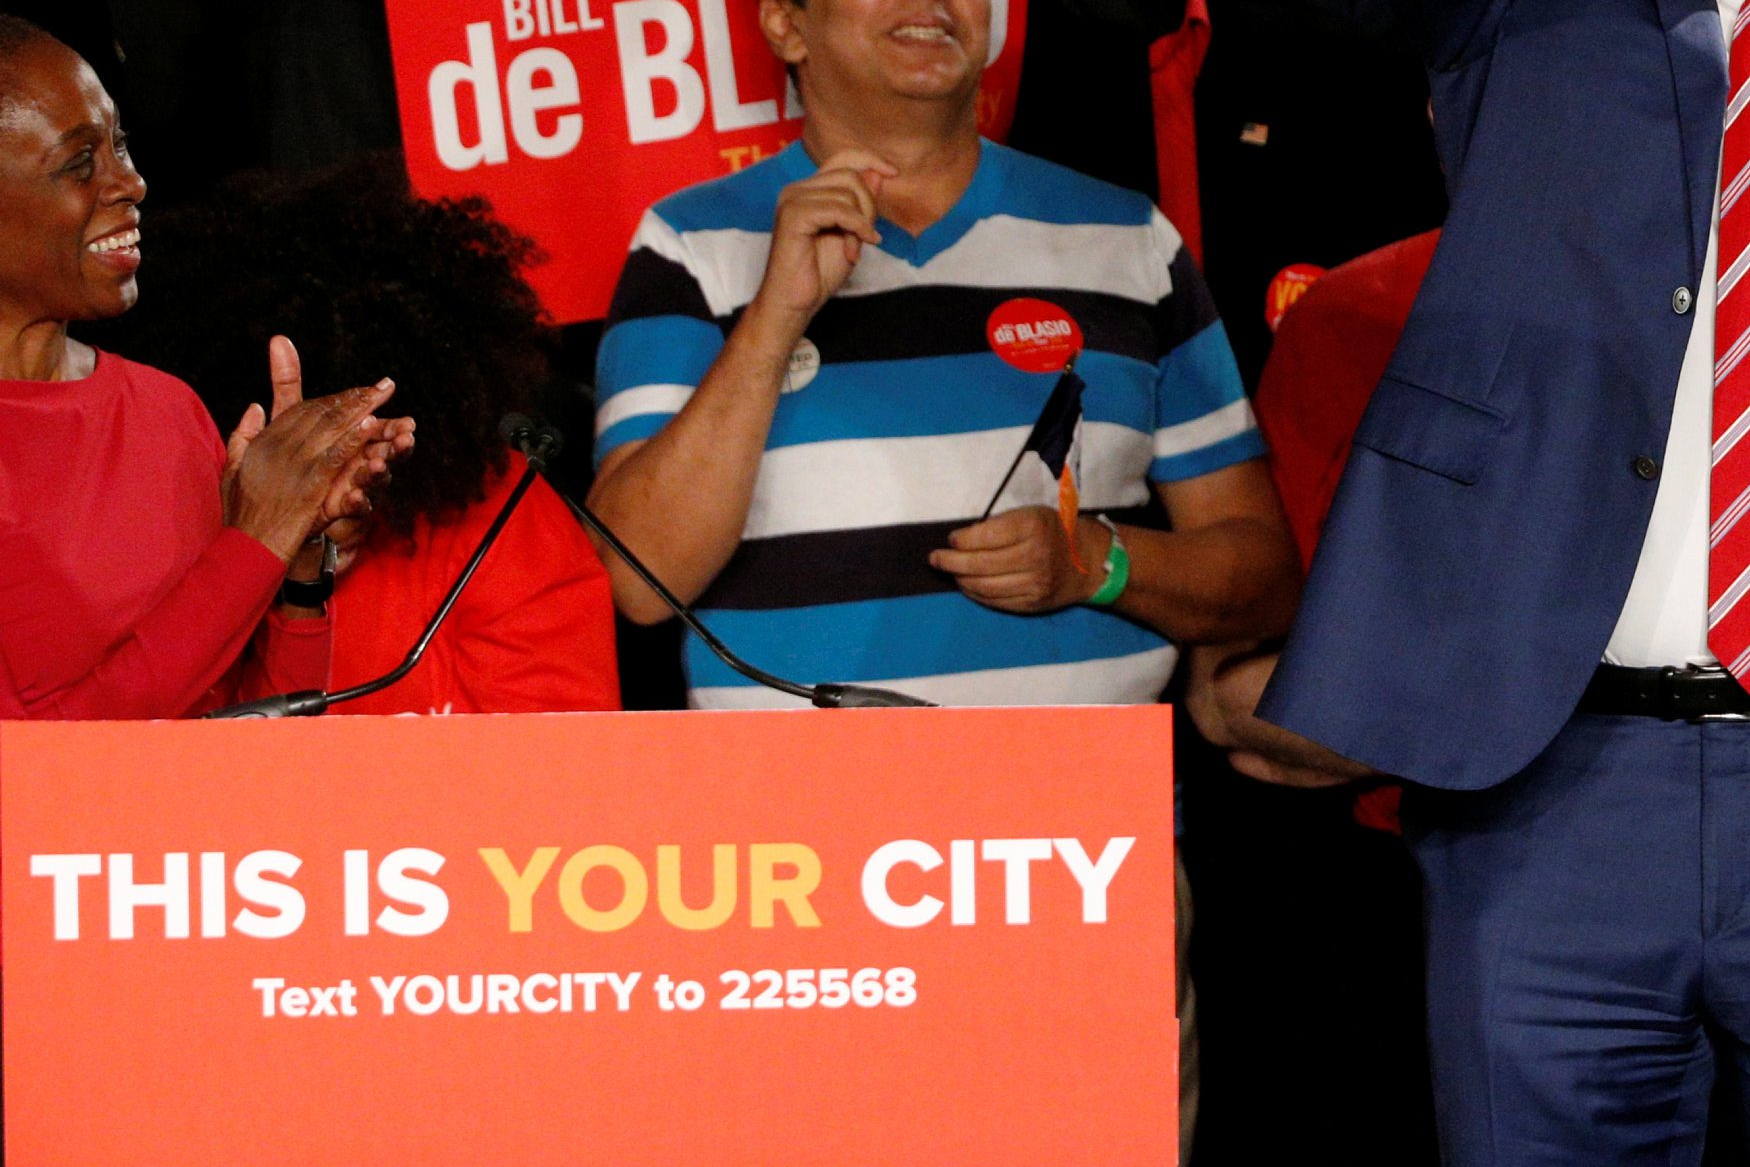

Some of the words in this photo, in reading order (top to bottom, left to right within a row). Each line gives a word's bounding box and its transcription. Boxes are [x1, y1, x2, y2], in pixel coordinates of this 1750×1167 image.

[427, 20, 585, 172] de
[30, 850, 307, 941] THIS
[343, 847, 450, 937] IS
[479, 843, 823, 933] YOUR
[860, 837, 1136, 928] CITY
[253, 977, 358, 1018] Text
[369, 971, 642, 1017] YOURCITY
[653, 973, 706, 1013] to
[719, 966, 918, 1011] 225568
